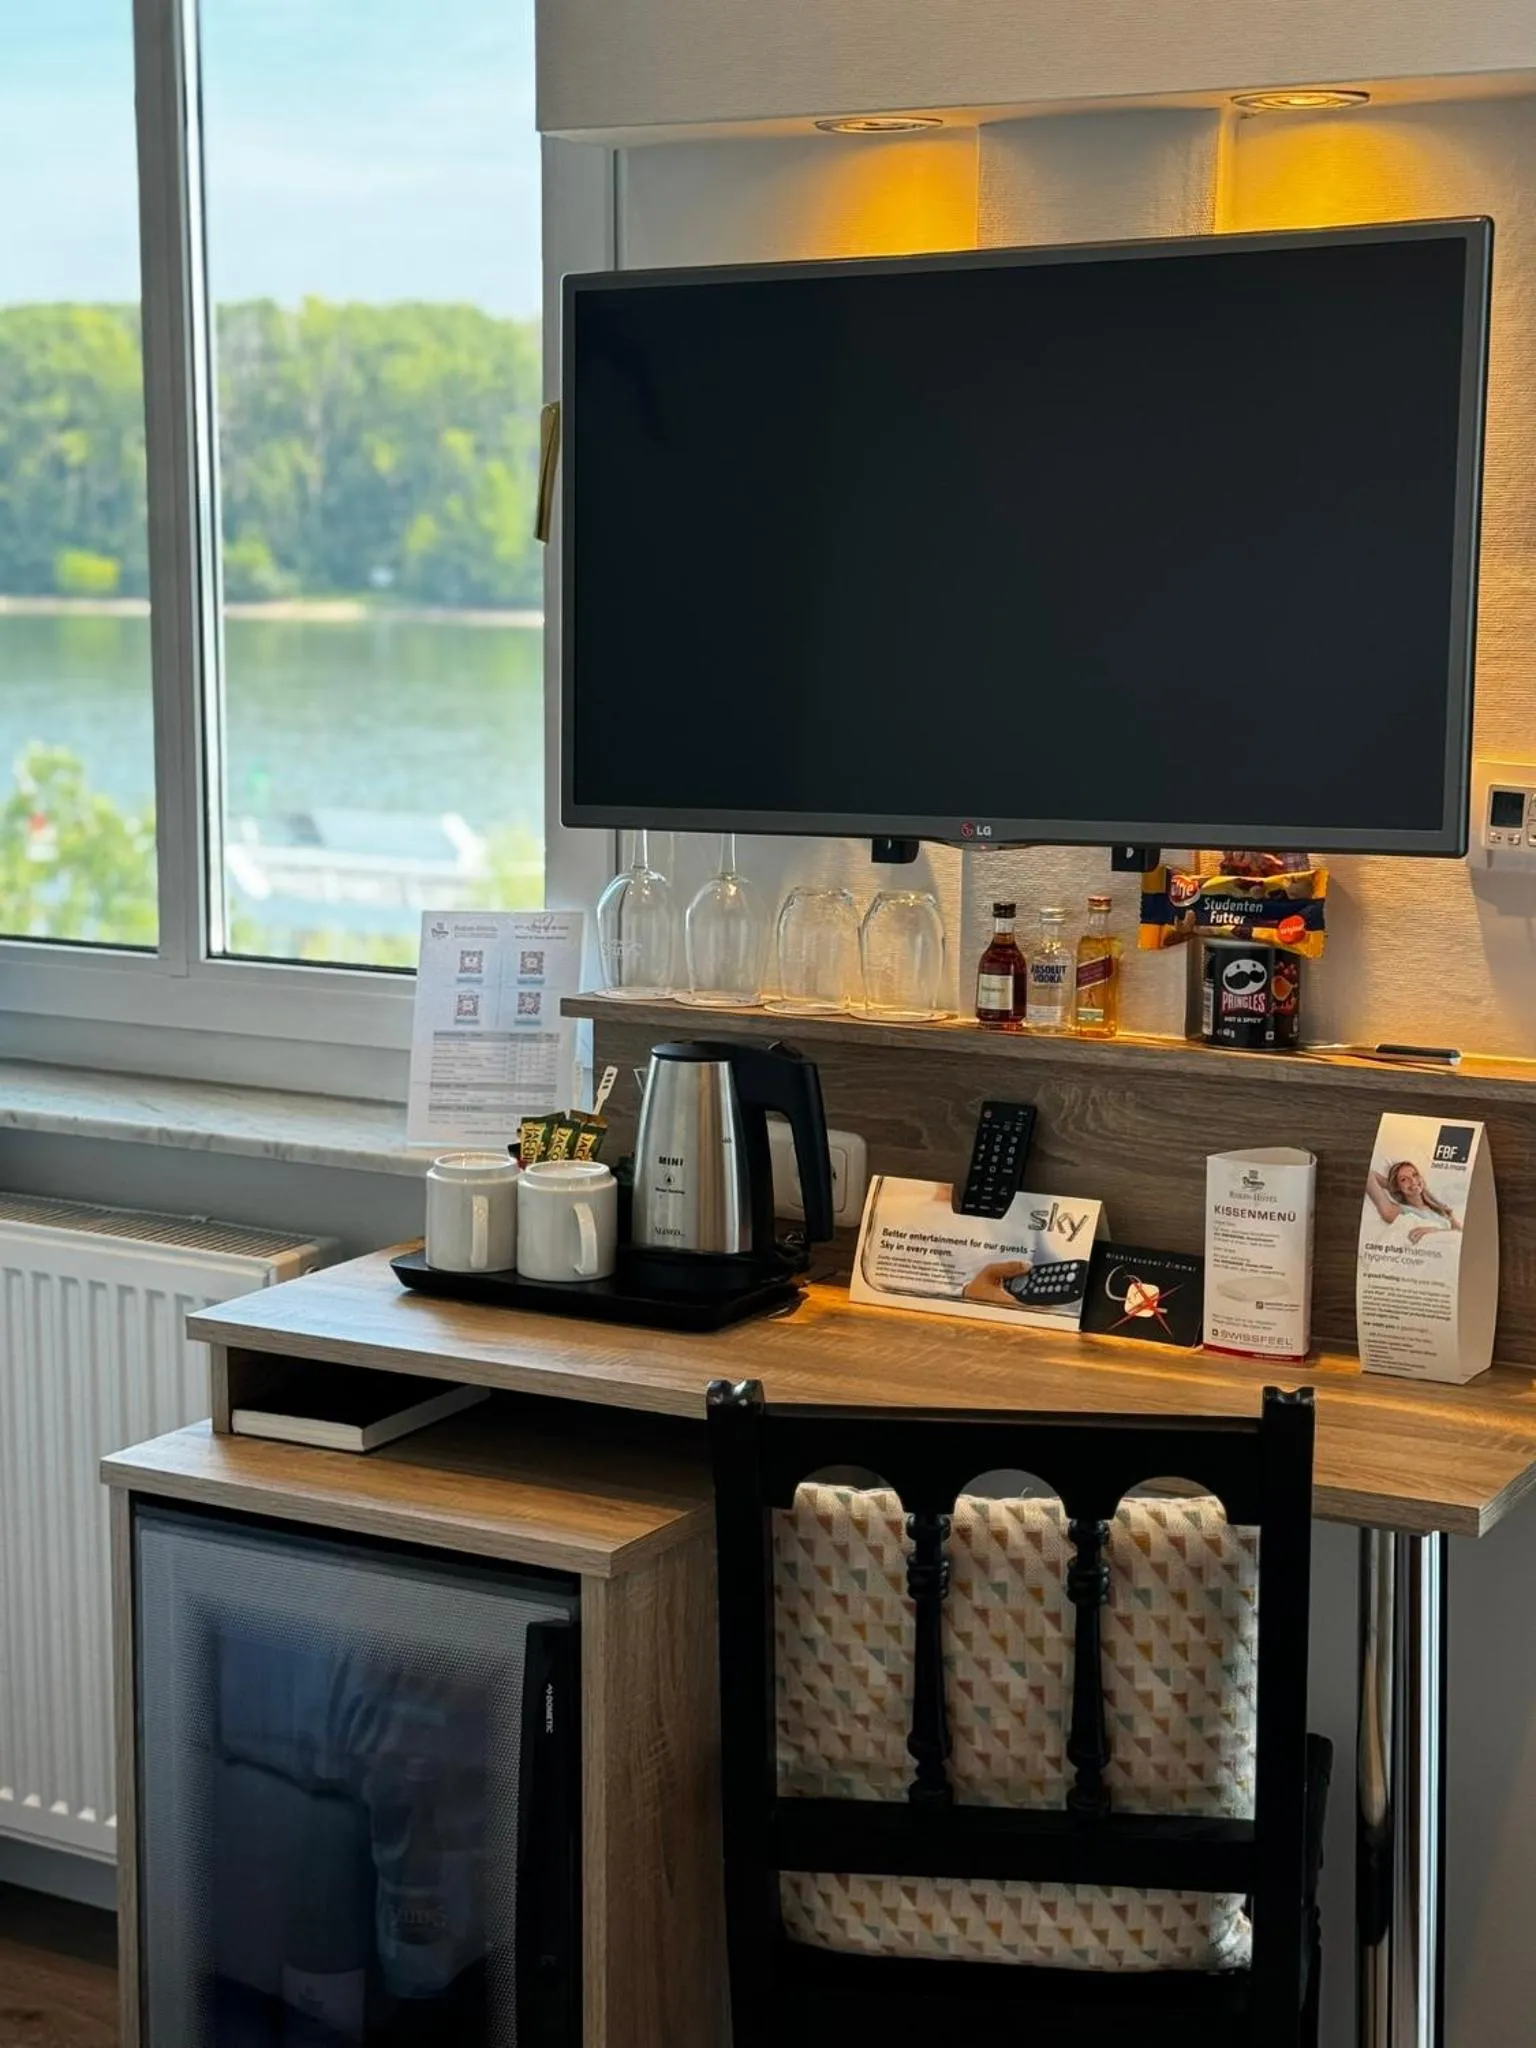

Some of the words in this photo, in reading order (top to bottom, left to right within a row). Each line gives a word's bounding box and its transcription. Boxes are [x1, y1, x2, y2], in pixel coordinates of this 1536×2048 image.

[976, 825, 992, 836] LG
[1204, 898, 1263, 914] Studenten
[1210, 910, 1247, 925] Futter
[1034, 974, 1063, 983] VODKA
[1222, 991, 1266, 1013] PRINGLES
[1436, 1145, 1458, 1160] FBF
[658, 1156, 684, 1167] MINI
[1213, 1204, 1297, 1223] KISSENMENÜ
[1028, 1202, 1088, 1242] sky
[880, 1240, 895, 1252] Sky
[896, 1242, 905, 1250] in
[906, 1245, 928, 1256] every
[929, 1248, 953, 1257] room.
[882, 1227, 908, 1240] Better
[909, 1232, 968, 1246] entertainment
[969, 1238, 983, 1248] for
[984, 1242, 998, 1250] our
[1000, 1244, 1028, 1255] guests
[1365, 1242, 1383, 1252] care
[1385, 1243, 1403, 1254] plus
[1401, 1257, 1425, 1266] cover
[1220, 1330, 1293, 1347] SWISSFEEL
